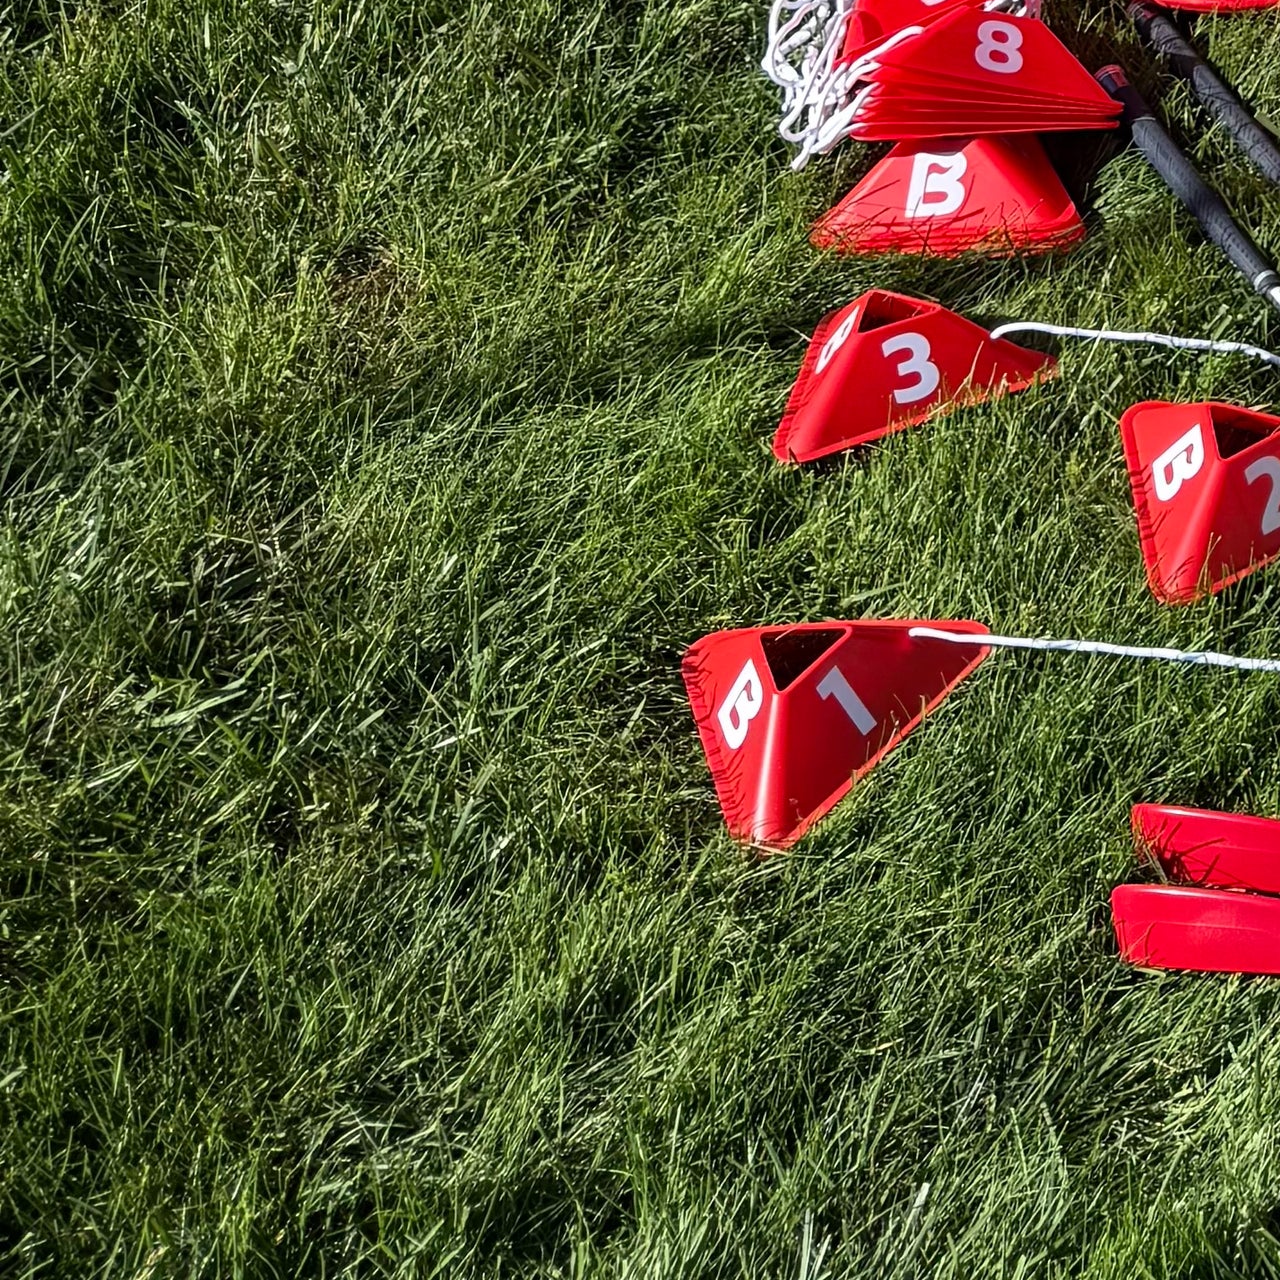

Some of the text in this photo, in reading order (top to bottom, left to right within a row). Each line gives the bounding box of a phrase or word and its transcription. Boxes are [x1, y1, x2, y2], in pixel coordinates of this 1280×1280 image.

[974, 20, 1024, 74] 8
[904, 151, 968, 219] B
[881, 332, 941, 404] 3
[1152, 423, 1206, 502] B
[717, 657, 764, 750] B
[815, 664, 878, 737] 1
